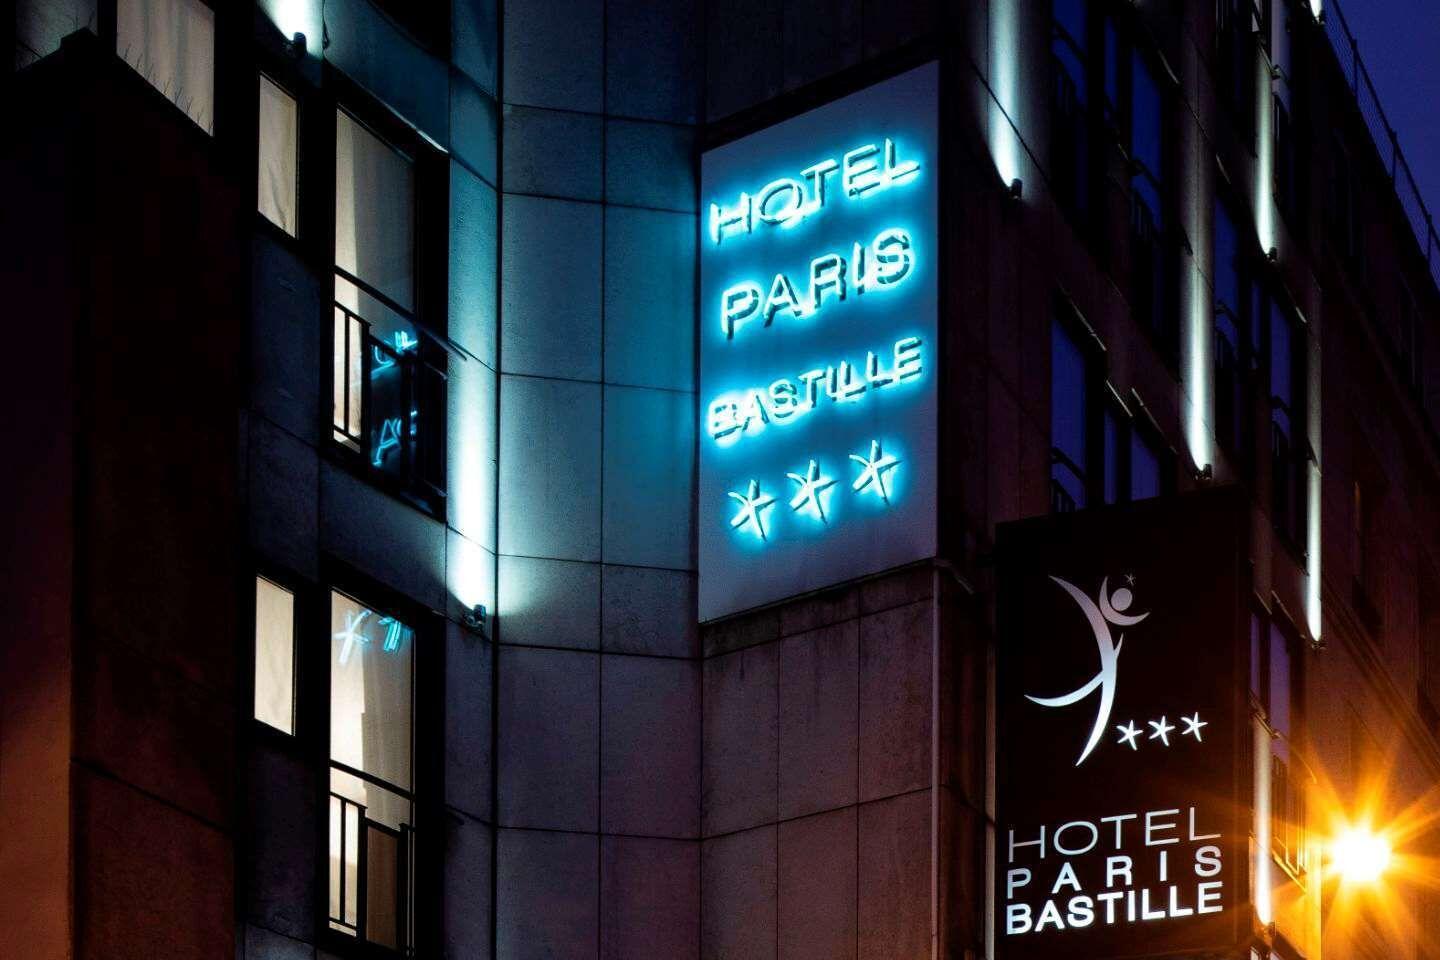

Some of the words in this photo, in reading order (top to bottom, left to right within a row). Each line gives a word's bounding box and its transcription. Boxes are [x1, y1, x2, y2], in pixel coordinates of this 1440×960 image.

[709, 137, 921, 246] HOTEL
[719, 226, 916, 340] PARIS
[708, 336, 924, 442] BASTILLE
[1006, 845, 1223, 899] PARIS
[1008, 806, 1222, 863] HOTEL
[1006, 880, 1224, 935] BASTILLE
